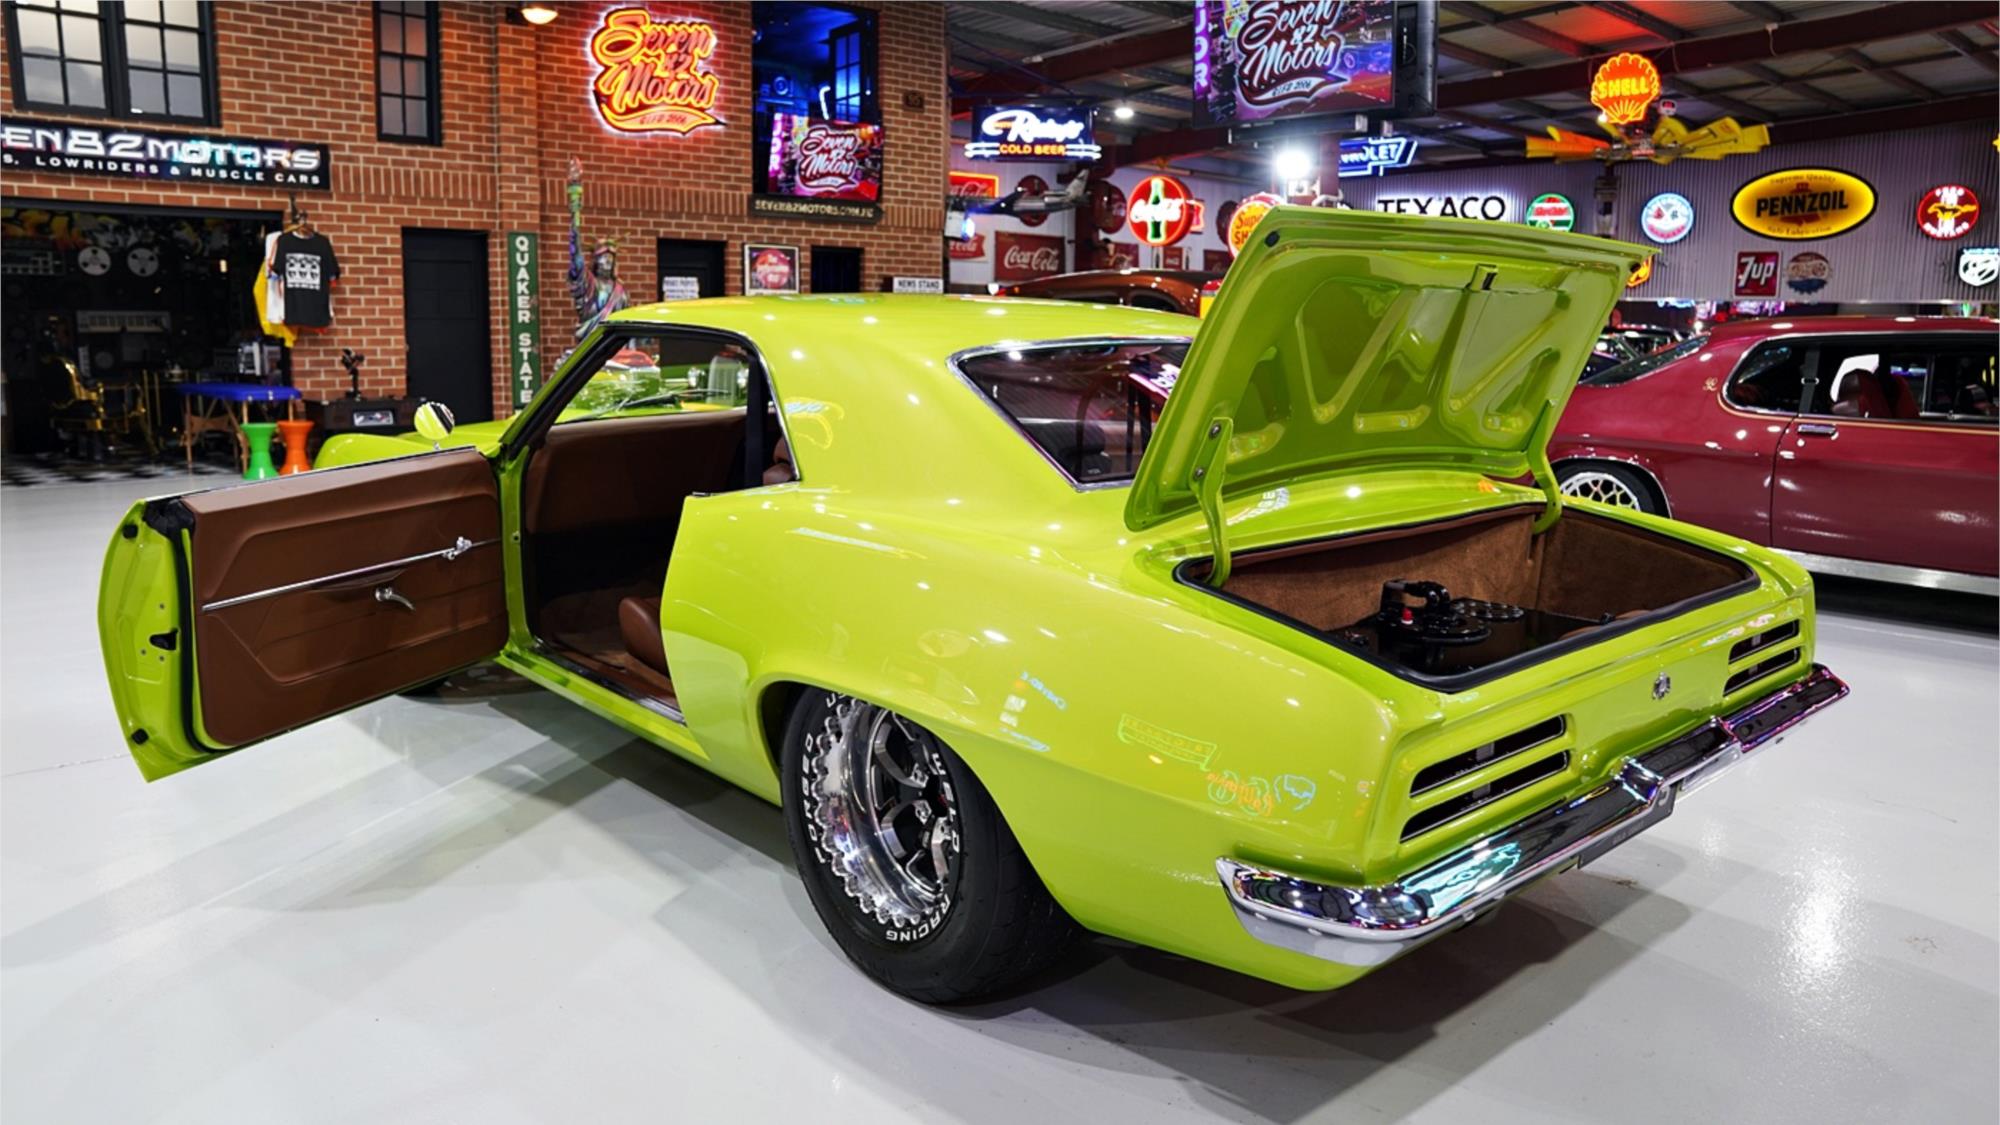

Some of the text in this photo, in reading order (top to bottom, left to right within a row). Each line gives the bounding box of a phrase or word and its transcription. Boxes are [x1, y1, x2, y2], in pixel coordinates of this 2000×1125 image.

[595, 9, 714, 66] Seven
[1242, 0, 1336, 50] Seven
[1243, 39, 1336, 88] Motors
[599, 60, 718, 113] Motors
[1598, 76, 1649, 99] SHELL
[1000, 144, 1066, 155] COLD BEER
[35, 155, 159, 175] LOWRIDERS
[170, 166, 181, 176] &
[191, 167, 265, 182] MUSCLE
[274, 173, 320, 185] CARS
[1378, 196, 1506, 221] TEXACO
[1756, 190, 1849, 217] PENNZOIL
[898, 279, 940, 290] NEWS STAND
[1738, 256, 1776, 288] 7up
[515, 235, 533, 404] QUAKER STATE
[885, 893, 951, 942] RACING
